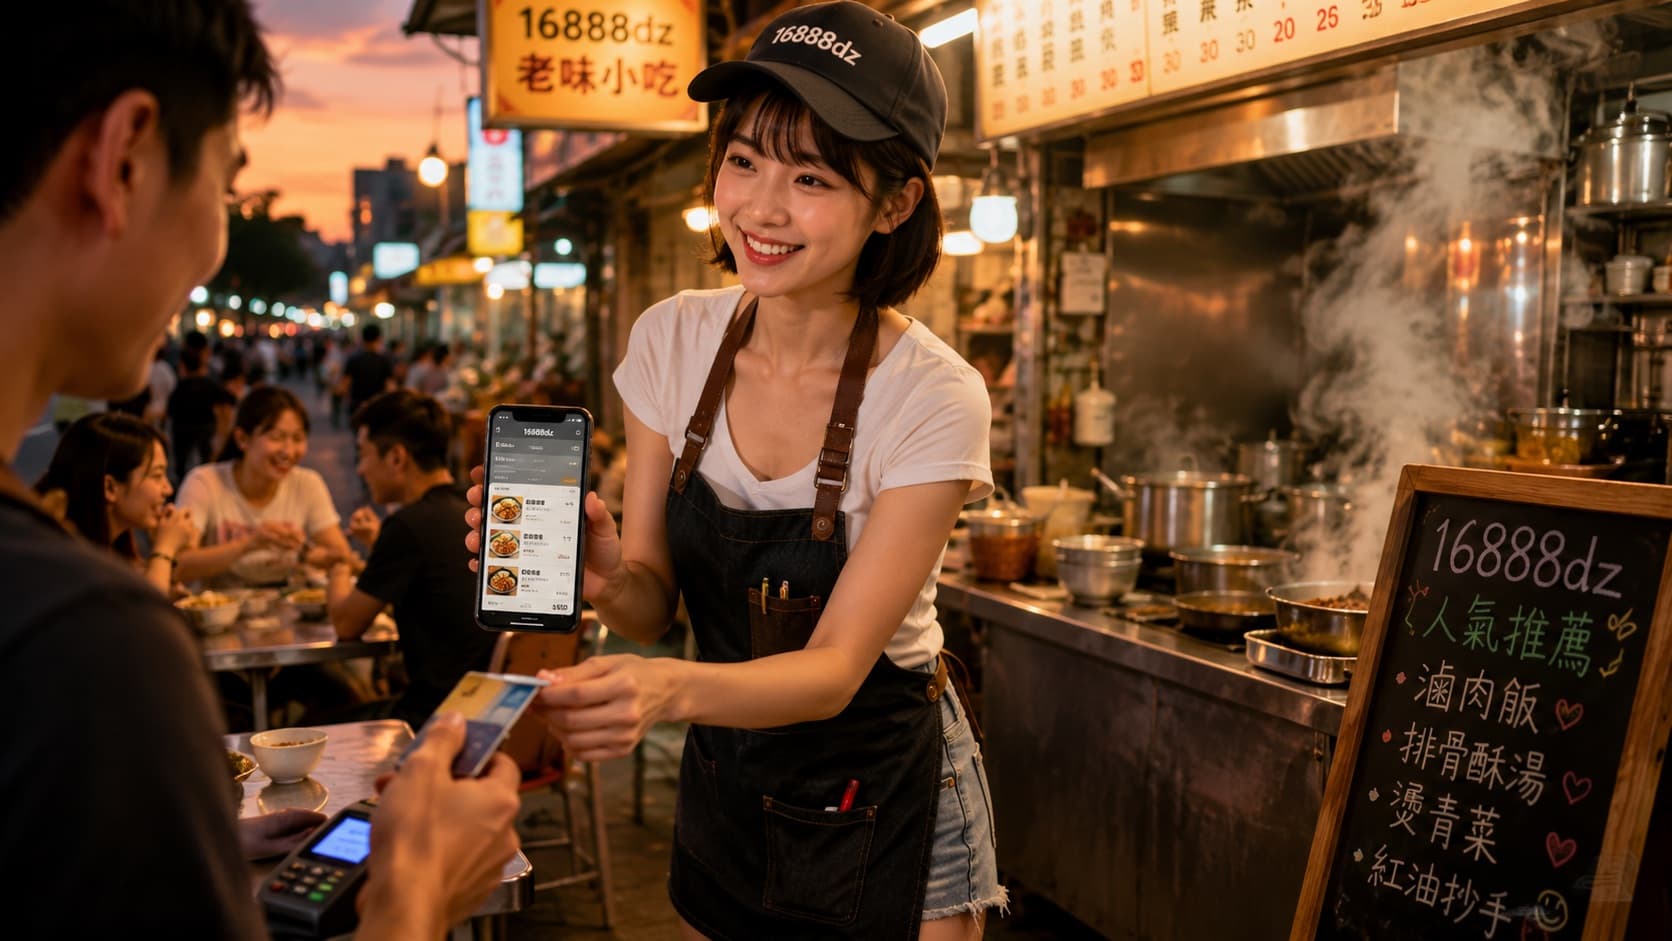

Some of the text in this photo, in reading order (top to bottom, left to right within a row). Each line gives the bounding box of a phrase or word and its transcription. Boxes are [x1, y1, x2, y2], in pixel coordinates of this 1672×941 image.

[519, 7, 674, 46] 16888dz
[772, 25, 862, 66] 16888dz
[1200, 40, 1218, 63] 30
[1236, 29, 1256, 53] 30
[1273, 17, 1295, 43] 20
[1316, 6, 1339, 32] 25
[517, 52, 679, 97] 老味小吃
[1433, 518, 1624, 599] 16888dz
[1422, 593, 1594, 678] 人氣推薦
[1414, 660, 1541, 734] 滷肉飯
[1399, 721, 1548, 806] 排骨酥湯
[1389, 780, 1500, 864] 燙青菜
[1368, 844, 1512, 939] 紅油抄手
